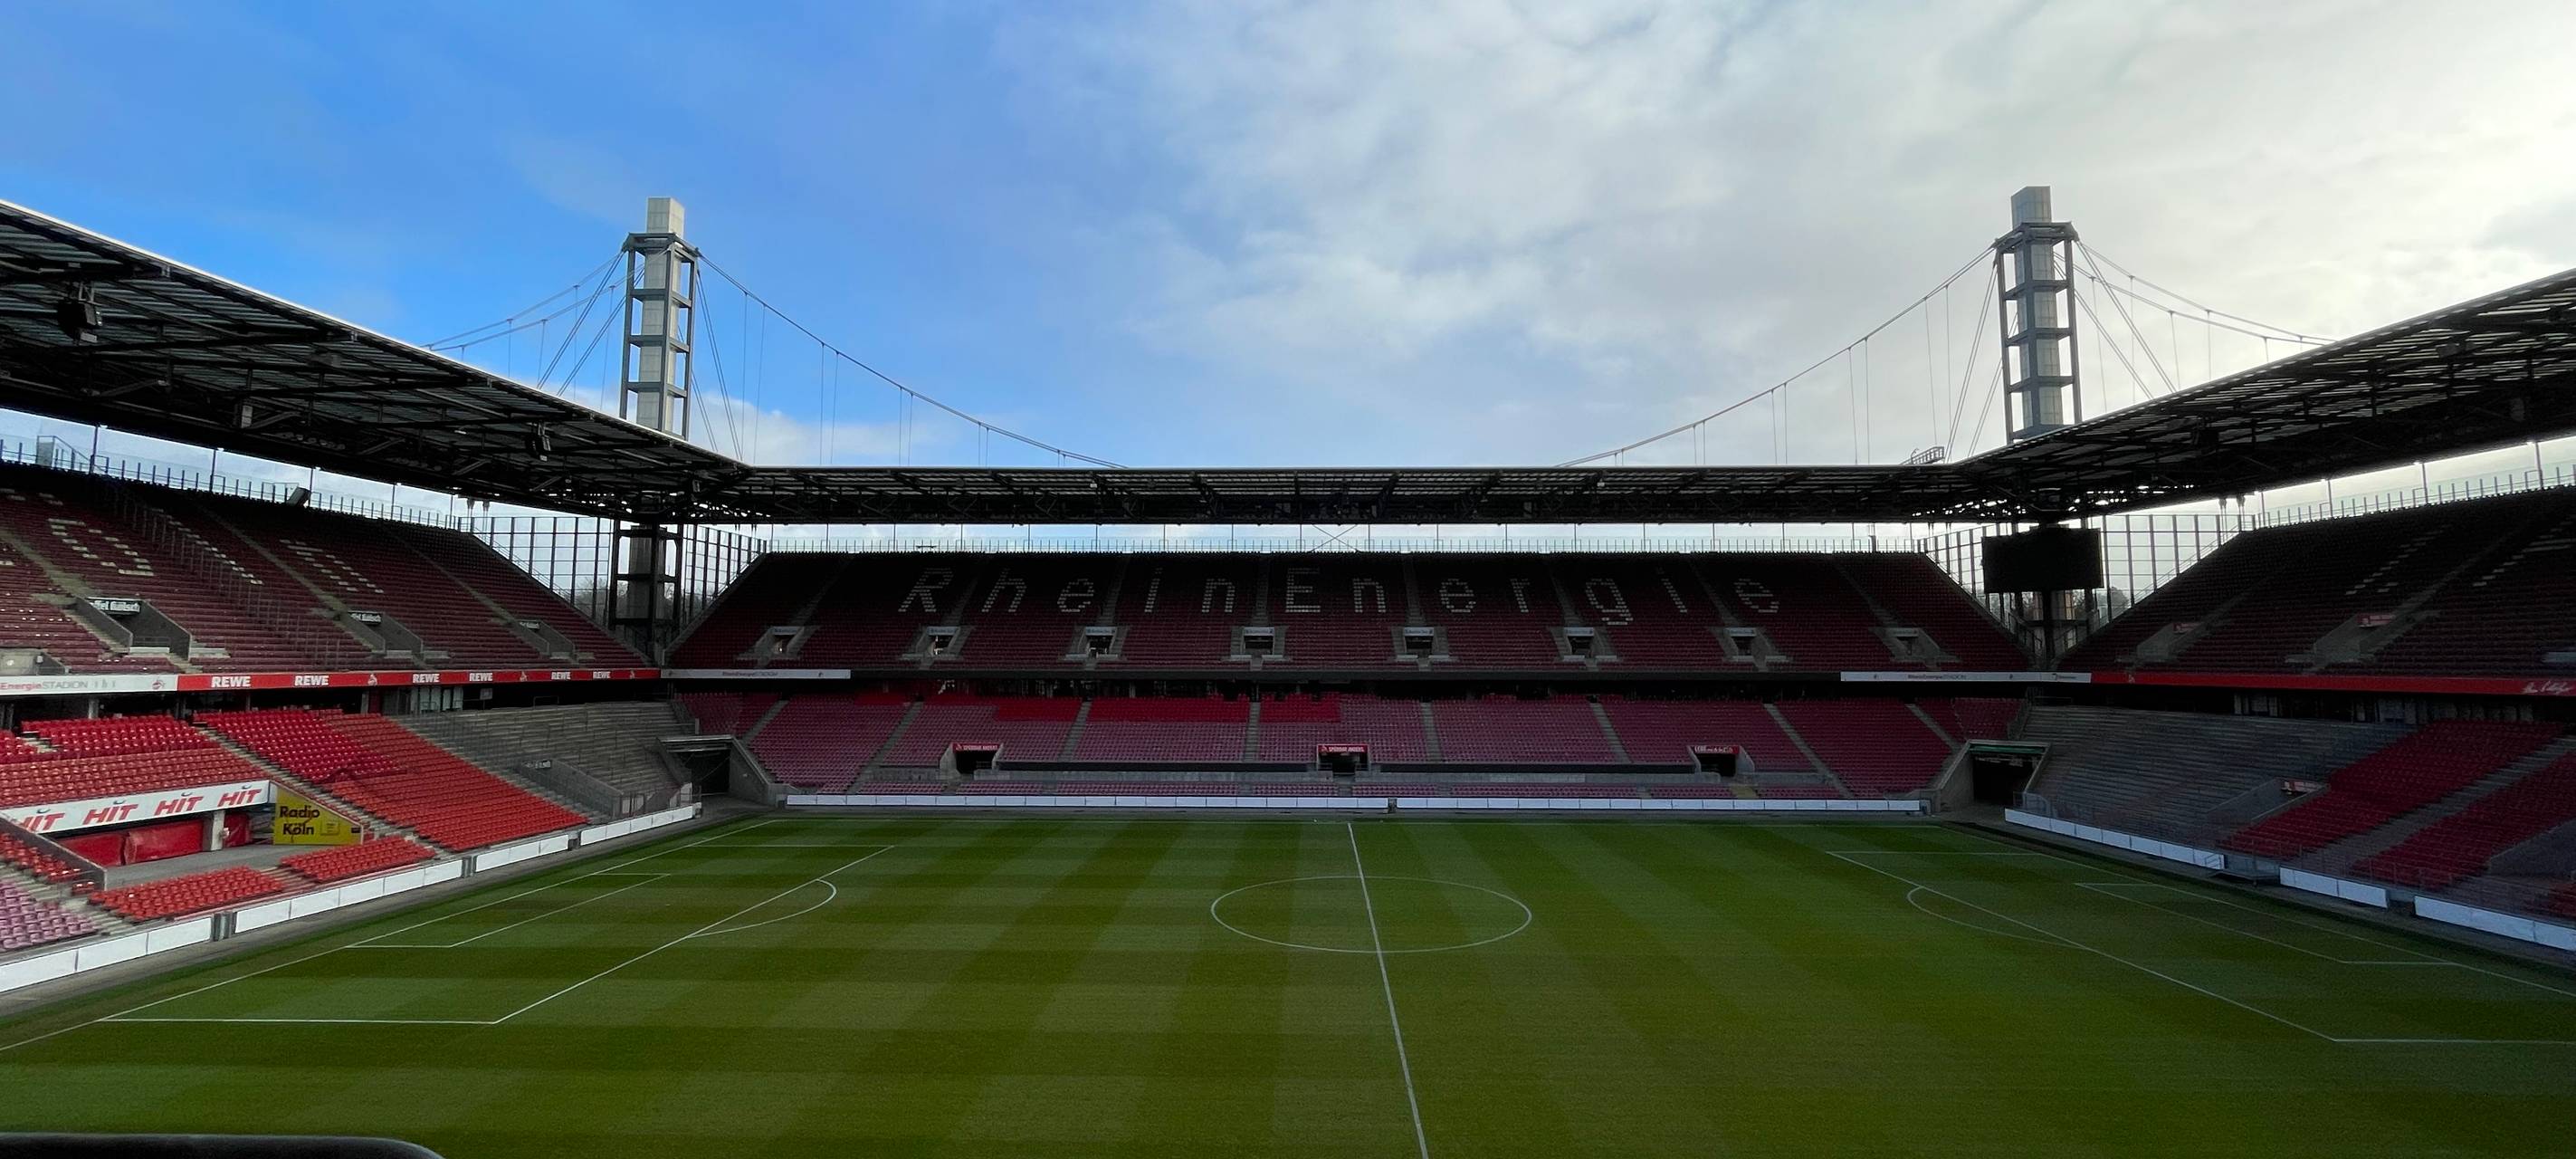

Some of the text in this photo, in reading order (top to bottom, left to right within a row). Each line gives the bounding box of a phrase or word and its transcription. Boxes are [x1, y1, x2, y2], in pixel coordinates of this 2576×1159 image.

[898, 567, 1780, 626] RheinEnergie
[211, 670, 611, 688] REWE REWE REWE REWE REWE REWE
[82, 803, 138, 825] HIT
[154, 795, 204, 817] HIT
[217, 787, 262, 808] HIT
[279, 804, 320, 819] Radio
[282, 822, 315, 836] Köln
